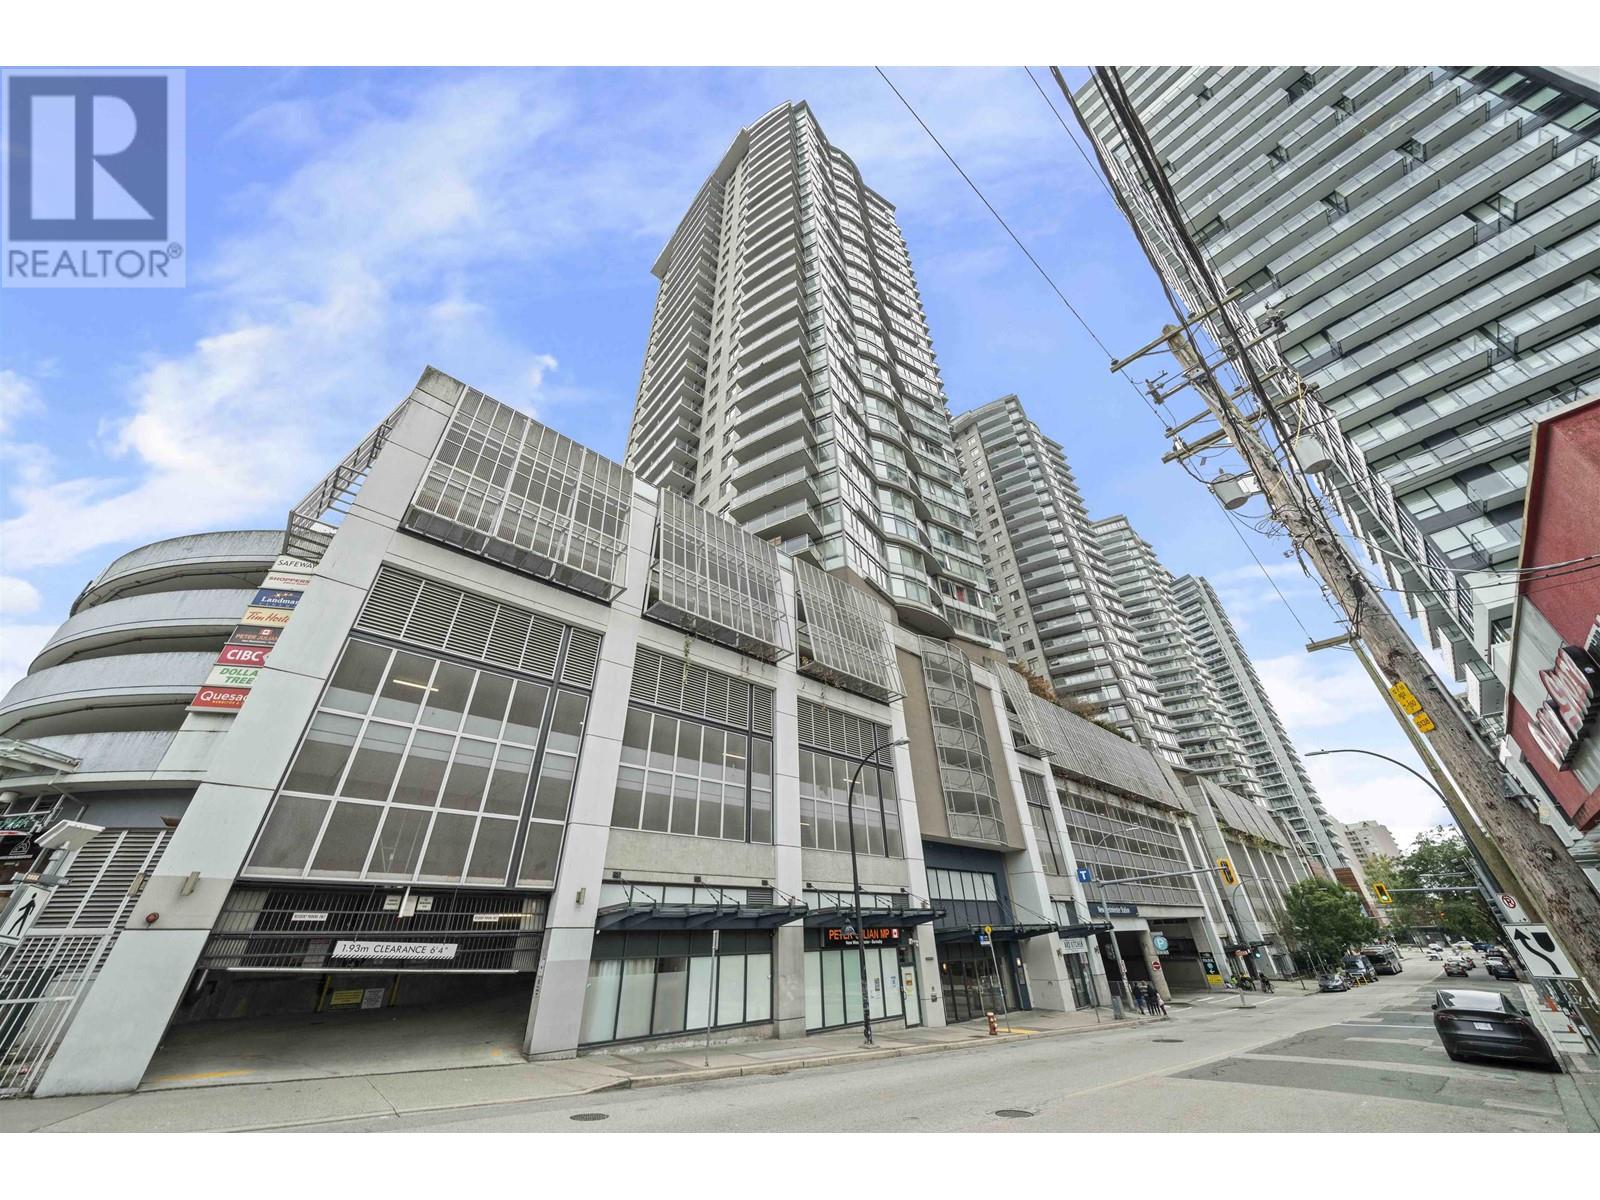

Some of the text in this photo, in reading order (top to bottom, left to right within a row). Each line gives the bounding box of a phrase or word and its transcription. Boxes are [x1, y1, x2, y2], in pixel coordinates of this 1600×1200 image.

[246, 611, 265, 621] Tim
[226, 649, 263, 661] CIBC
[225, 676, 255, 685] TREE
[1080, 871, 1087, 880] T
[880, 929, 890, 938] MP
[341, 944, 369, 953] 1.93m
[373, 944, 428, 954] CLEARANCE
